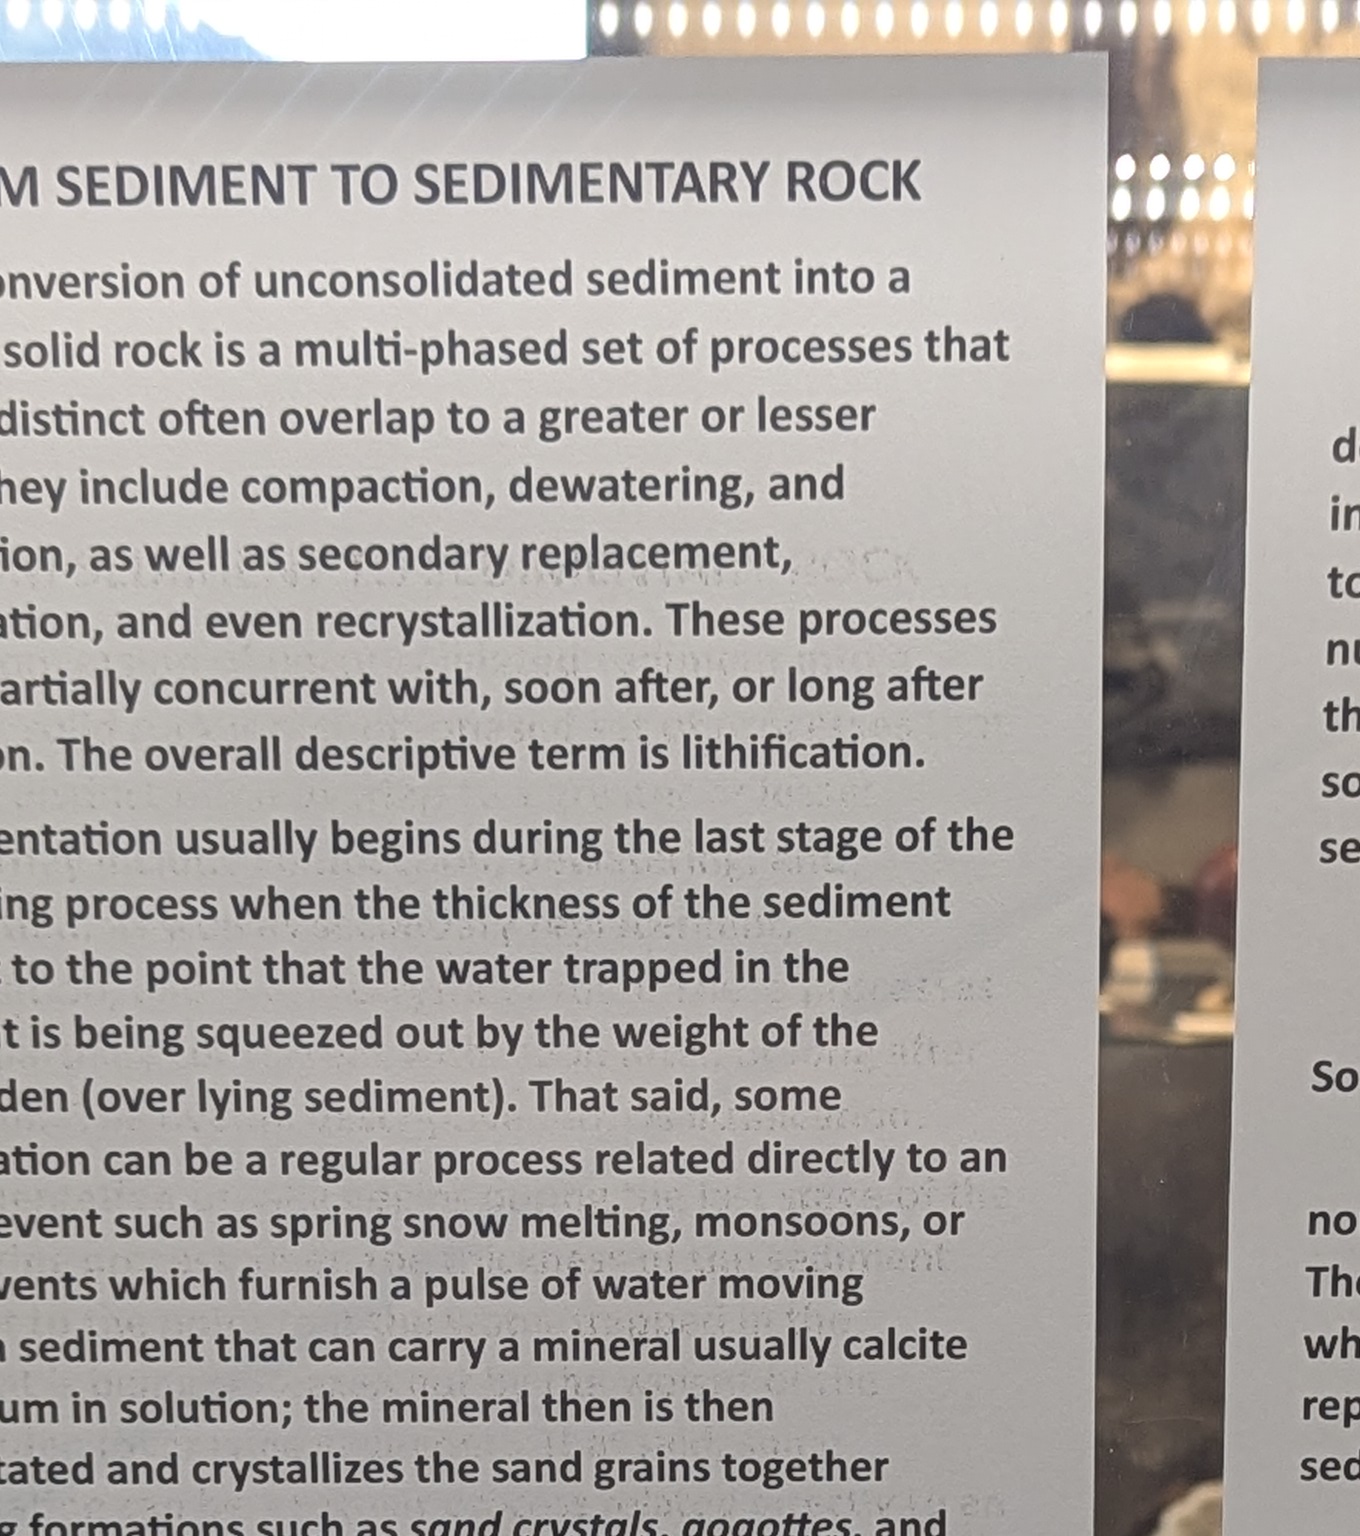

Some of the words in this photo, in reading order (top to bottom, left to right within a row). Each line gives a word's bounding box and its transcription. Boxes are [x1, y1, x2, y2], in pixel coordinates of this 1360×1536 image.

[57, 164, 317, 206] SEDIMENT
[331, 164, 397, 205] TO
[415, 161, 770, 204] SEDIMENTARY
[788, 160, 921, 201] ROCK
[199, 261, 241, 298] of
[255, 259, 572, 298] unconsolidated
[588, 258, 780, 296] sediment
[795, 258, 874, 294] into
[889, 267, 909, 293] a
[159, 399, 265, 435] often
[280, 398, 434, 443] overlap
[447, 402, 489, 434] to
[504, 408, 524, 434] a
[539, 401, 688, 442] greater
[702, 406, 744, 432] or
[758, 395, 876, 432] lesser
[1312, 1061, 1358, 1092] So
[83, 1078, 186, 1120] (over
[198, 1078, 292, 1121] lying
[305, 1077, 516, 1120] sediment).
[529, 1078, 618, 1112] That
[631, 1077, 721, 1118] said,
[735, 1086, 841, 1111] some
[108, 1452, 178, 1484] and
[193, 1451, 403, 1492] crystallizes
[414, 1451, 479, 1483] the
[493, 1450, 581, 1483] sand
[594, 1450, 710, 1490] grains
[721, 1449, 889, 1489] together
